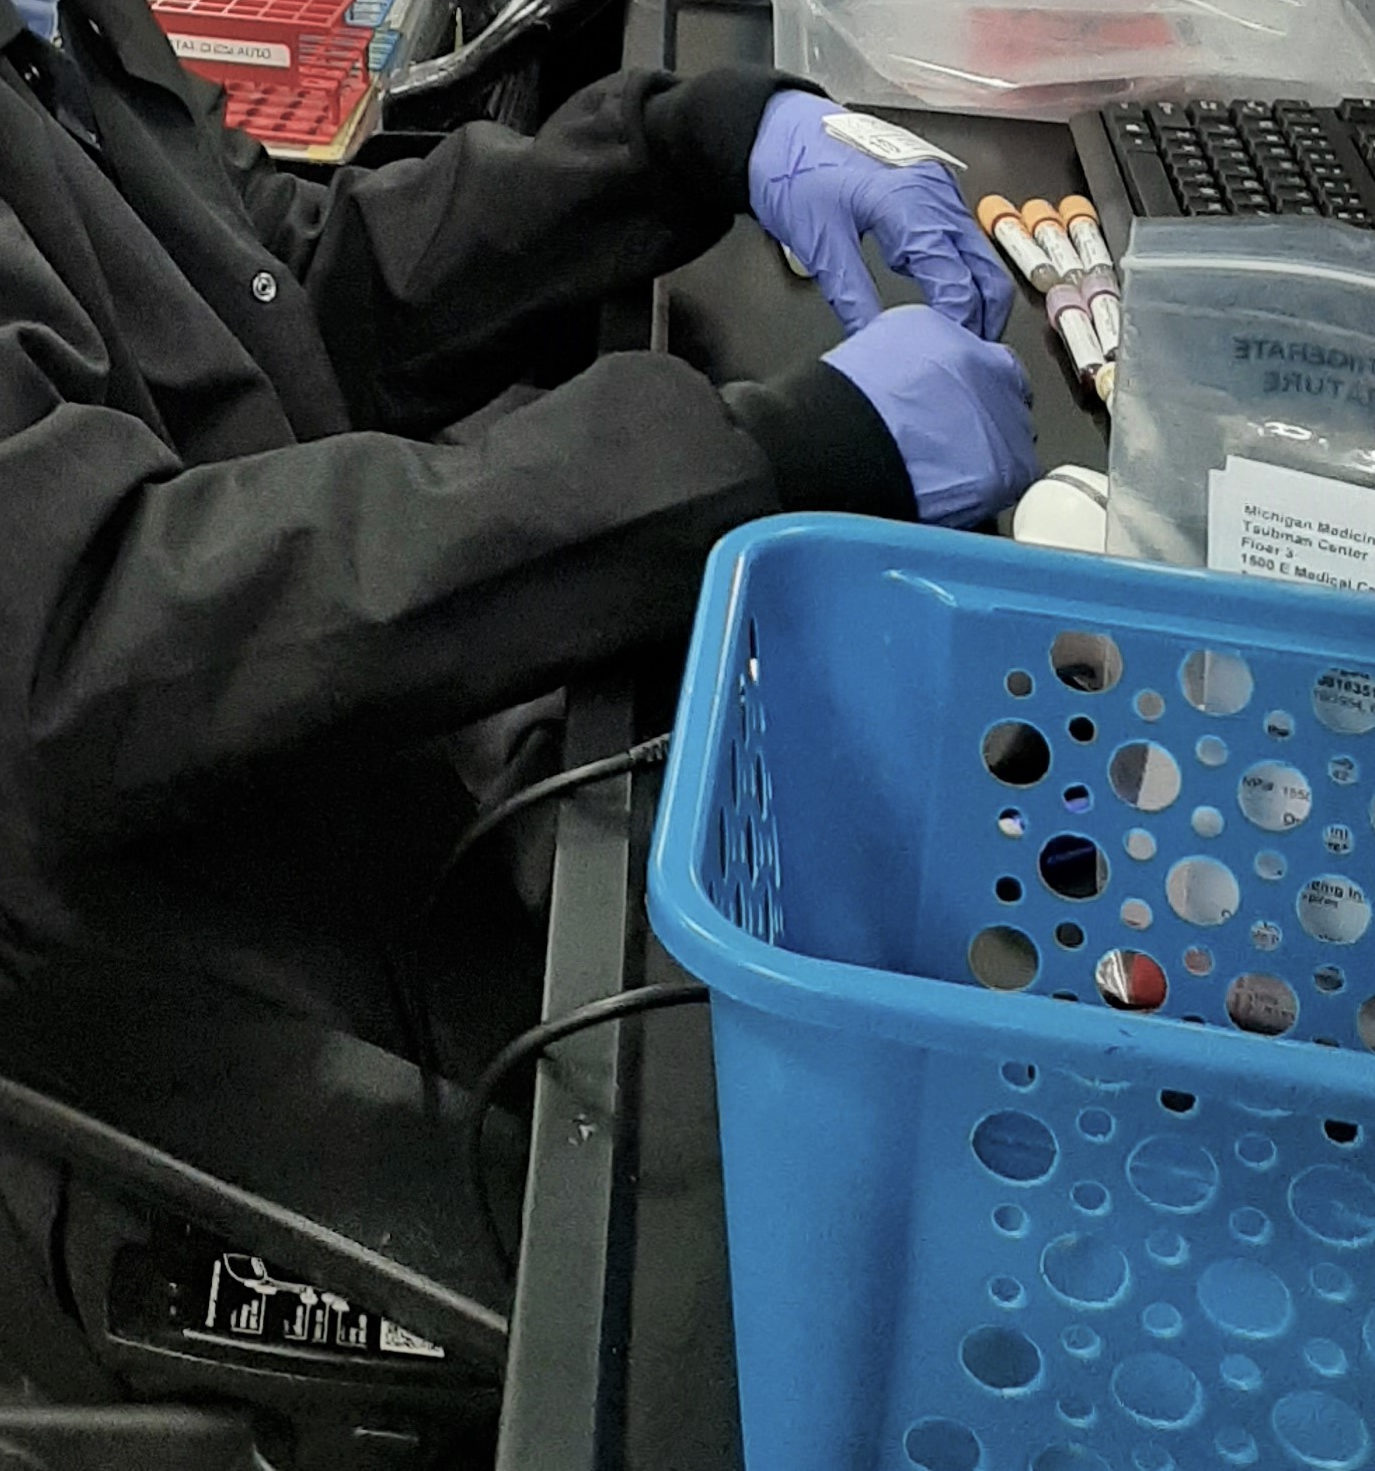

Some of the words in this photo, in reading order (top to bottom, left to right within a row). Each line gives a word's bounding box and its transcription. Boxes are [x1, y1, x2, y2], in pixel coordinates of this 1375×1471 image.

[237, 47, 272, 60] AUTO
[1244, 504, 1312, 530] Michigan
[1317, 538, 1369, 562] Center
[1293, 564, 1352, 591] Medical
